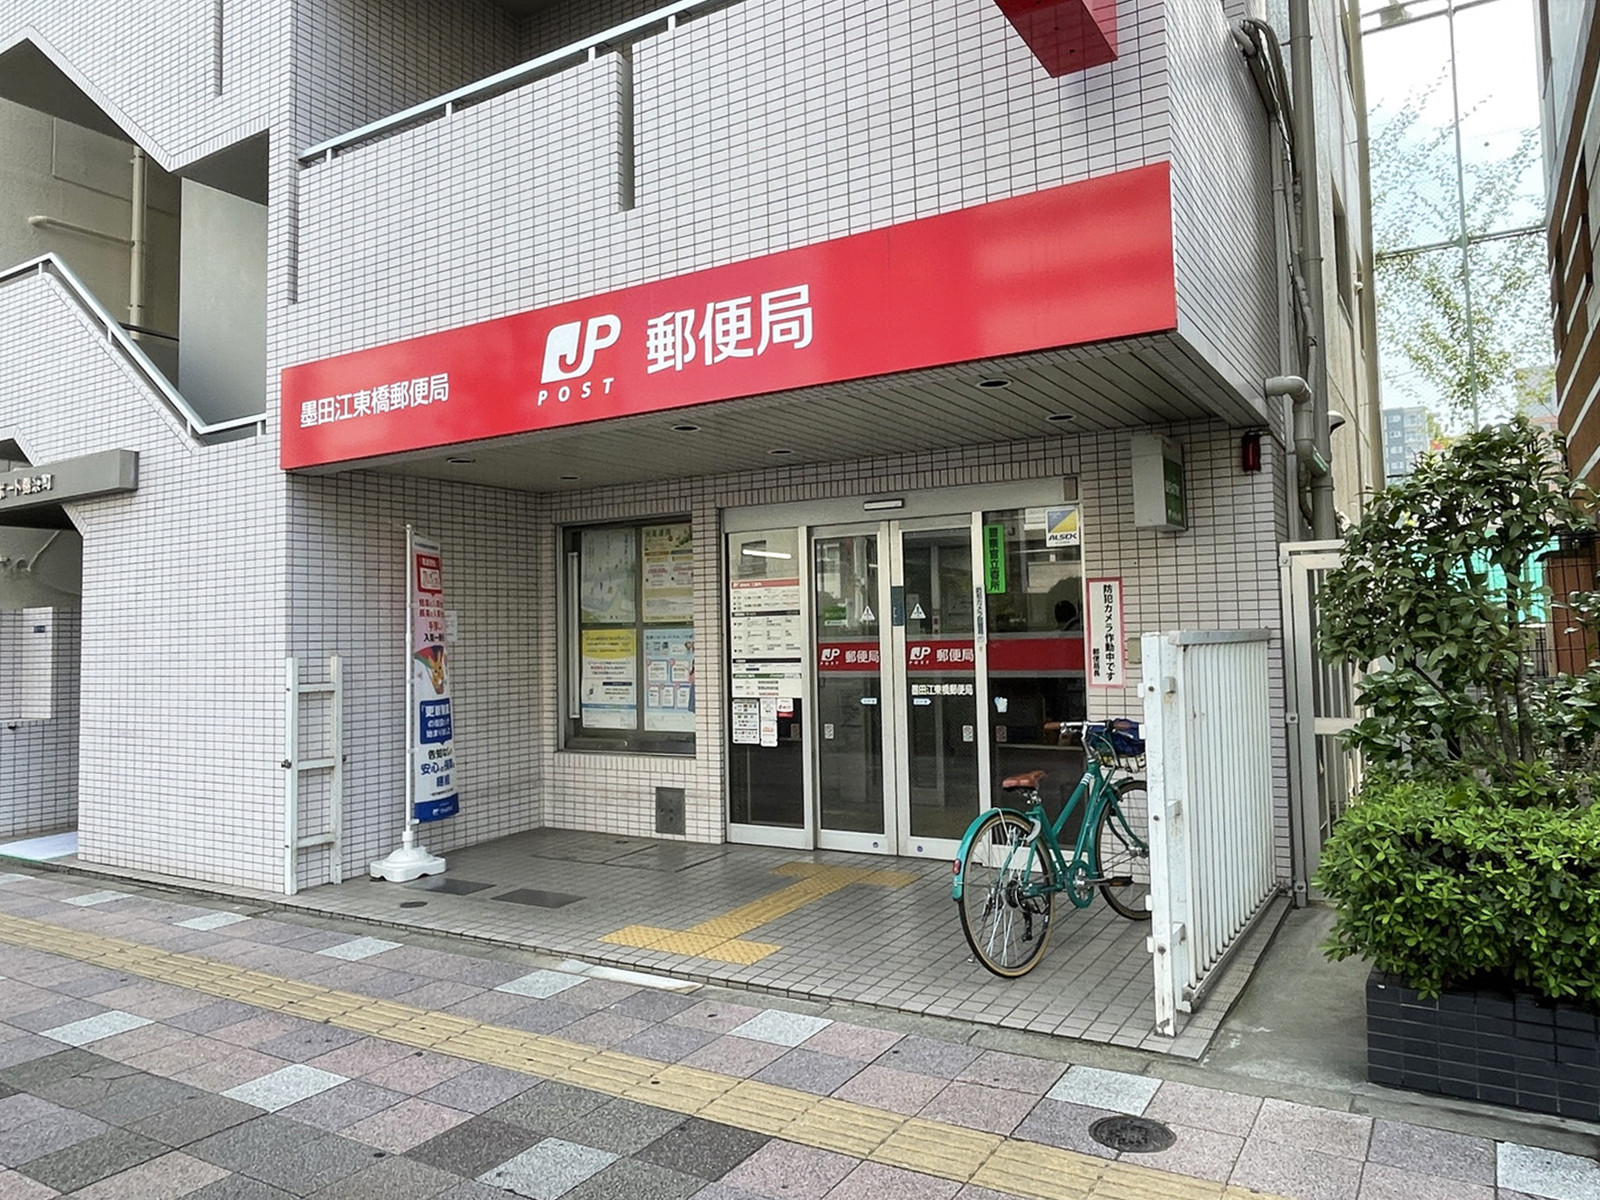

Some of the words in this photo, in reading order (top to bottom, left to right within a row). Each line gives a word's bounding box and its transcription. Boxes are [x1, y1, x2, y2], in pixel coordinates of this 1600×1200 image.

[646, 284, 813, 374] 郵便局
[300, 373, 449, 428] 墨田江東橋郵便局
[538, 377, 614, 406] POST
[1049, 533, 1077, 541] ALSOK
[1103, 584, 1115, 681] 防犯カメラ作動中です
[845, 650, 879, 664] 郵便局
[936, 648, 974, 662] 郵便局
